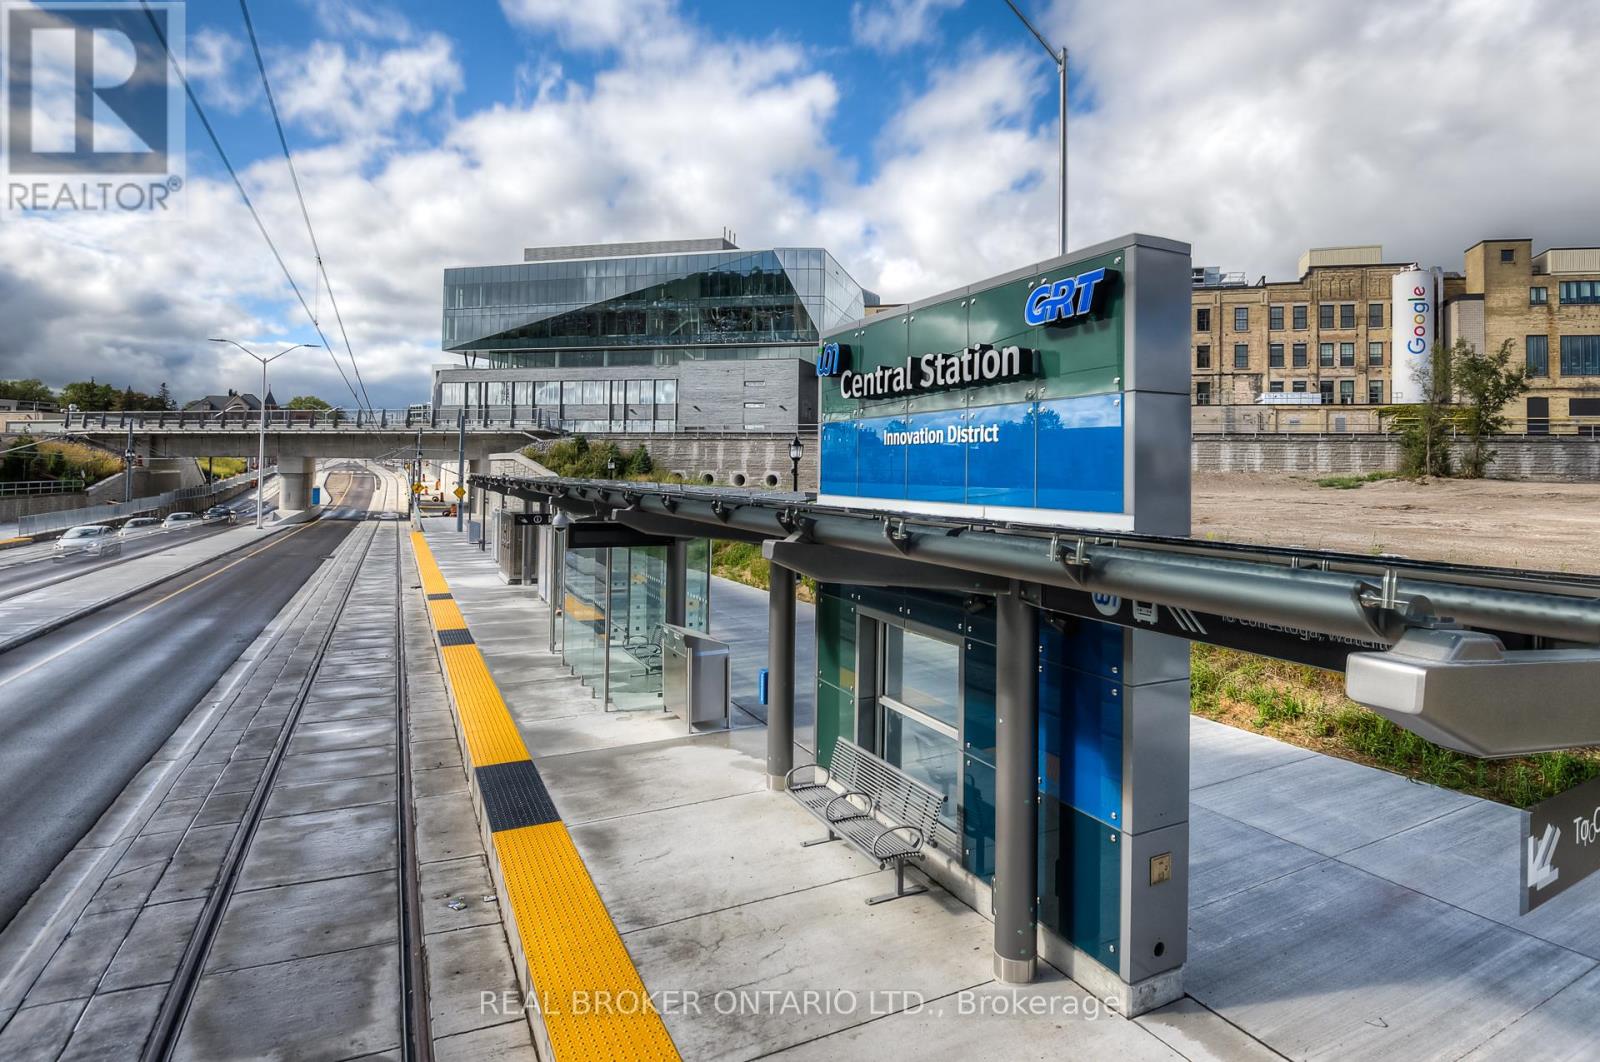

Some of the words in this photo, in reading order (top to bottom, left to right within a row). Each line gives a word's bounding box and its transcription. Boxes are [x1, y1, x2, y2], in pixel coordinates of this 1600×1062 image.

[1025, 268, 1105, 326] GRT
[1407, 286, 1430, 354] Google
[841, 356, 912, 399] Central
[920, 343, 1020, 388] Station
[883, 425, 944, 446] Innovation
[947, 423, 999, 444] District
